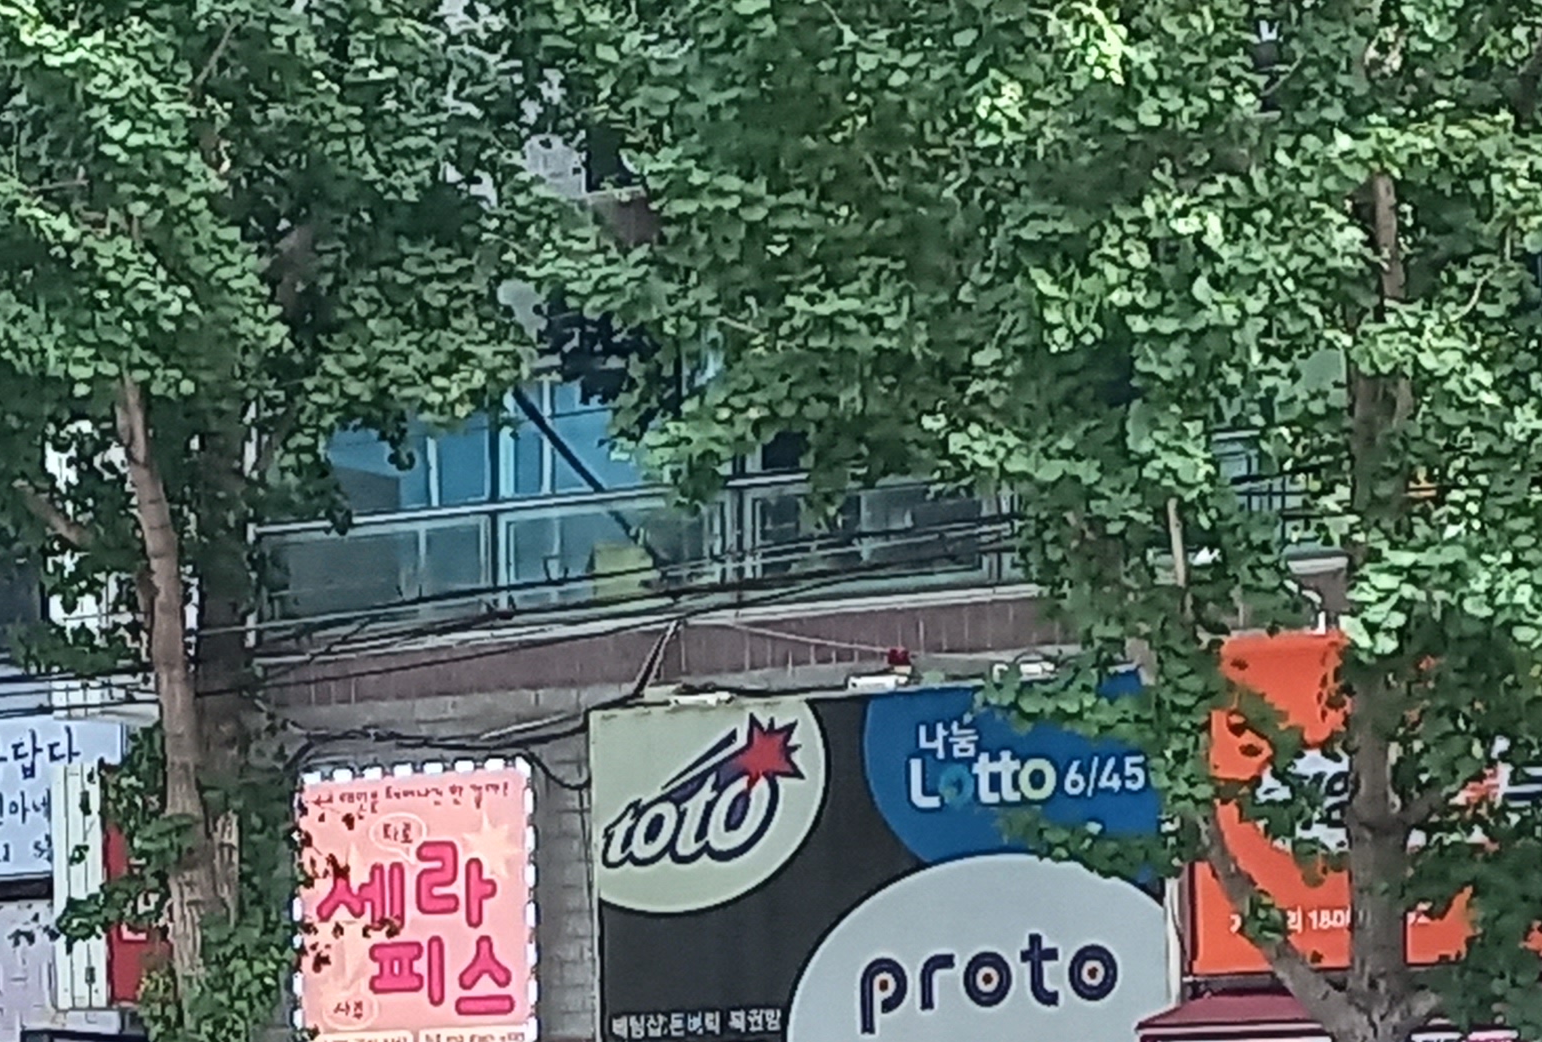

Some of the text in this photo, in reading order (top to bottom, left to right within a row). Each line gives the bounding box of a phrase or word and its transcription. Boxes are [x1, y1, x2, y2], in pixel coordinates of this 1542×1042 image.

[909, 752, 1146, 812] Lotto 6/45
[918, 721, 979, 757] 나눔
[602, 770, 781, 870] toto
[316, 840, 497, 932] 세라
[368, 935, 515, 1017] 피스
[860, 932, 1118, 1036] proto
